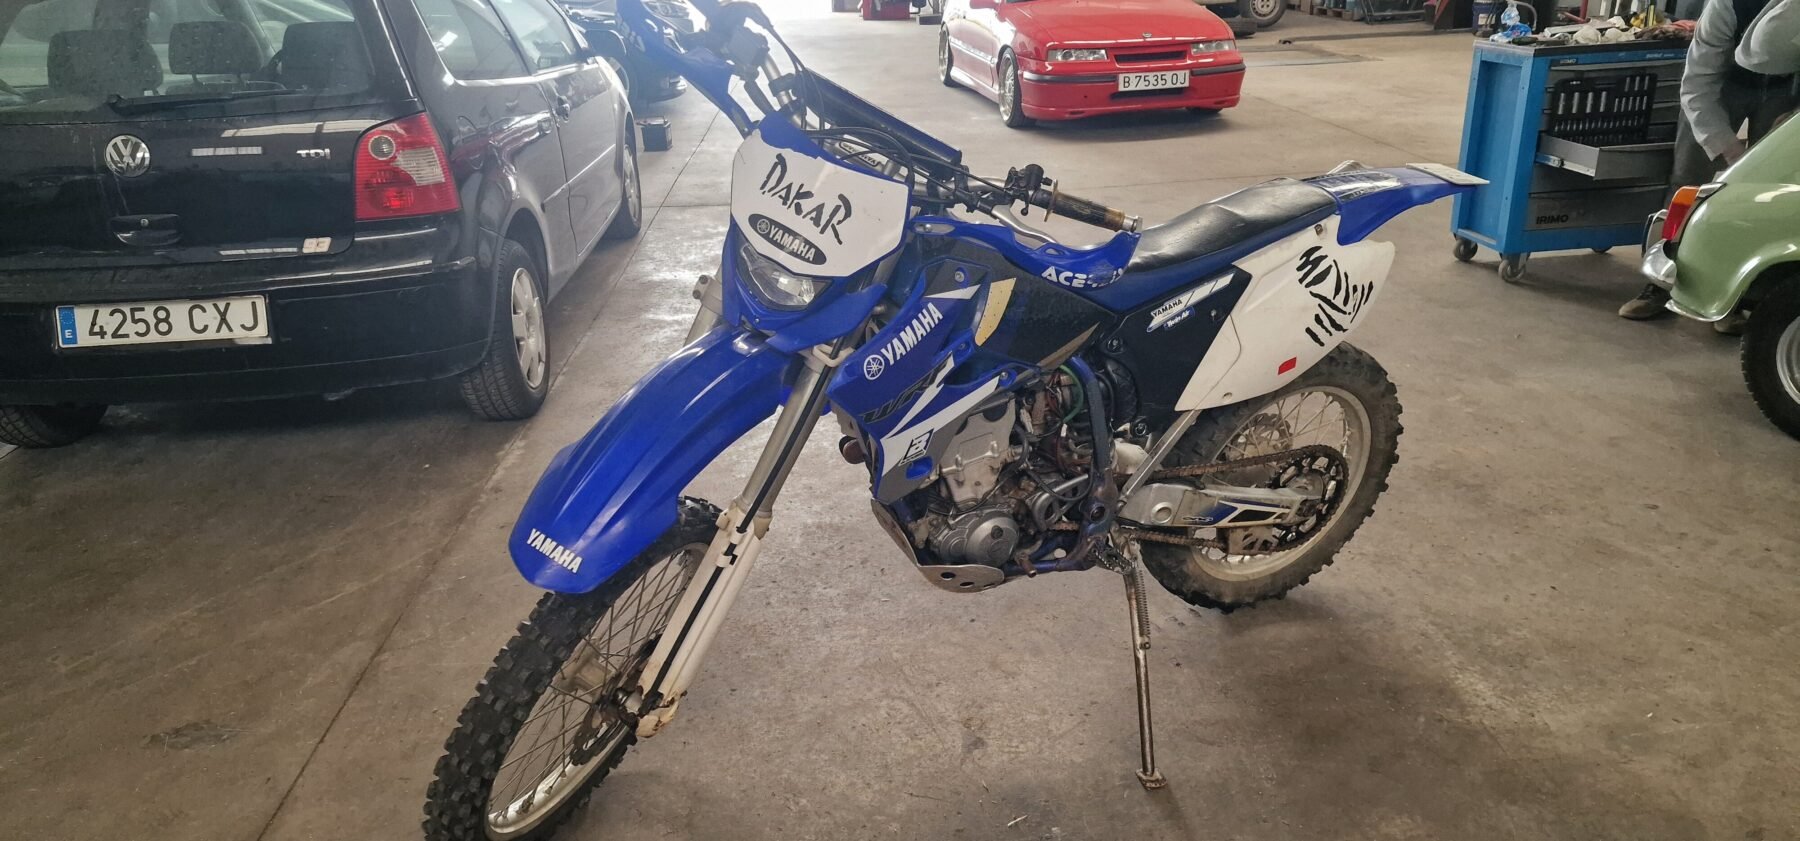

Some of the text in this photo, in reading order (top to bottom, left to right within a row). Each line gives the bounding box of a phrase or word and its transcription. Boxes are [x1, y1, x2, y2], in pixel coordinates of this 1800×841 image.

[1123, 75, 1131, 89] B
[1134, 73, 1168, 88] 7535
[296, 148, 331, 160] TDI
[759, 152, 852, 245] DAKAR
[1535, 214, 1569, 225] IRIMO
[769, 225, 816, 261] YAMAHA
[88, 301, 260, 340] 4258 CXJ
[1152, 299, 1183, 317] YAMAHA
[64, 329, 73, 339] E
[880, 302, 944, 366] YAMAHA
[526, 527, 583, 574] YAMAHA
